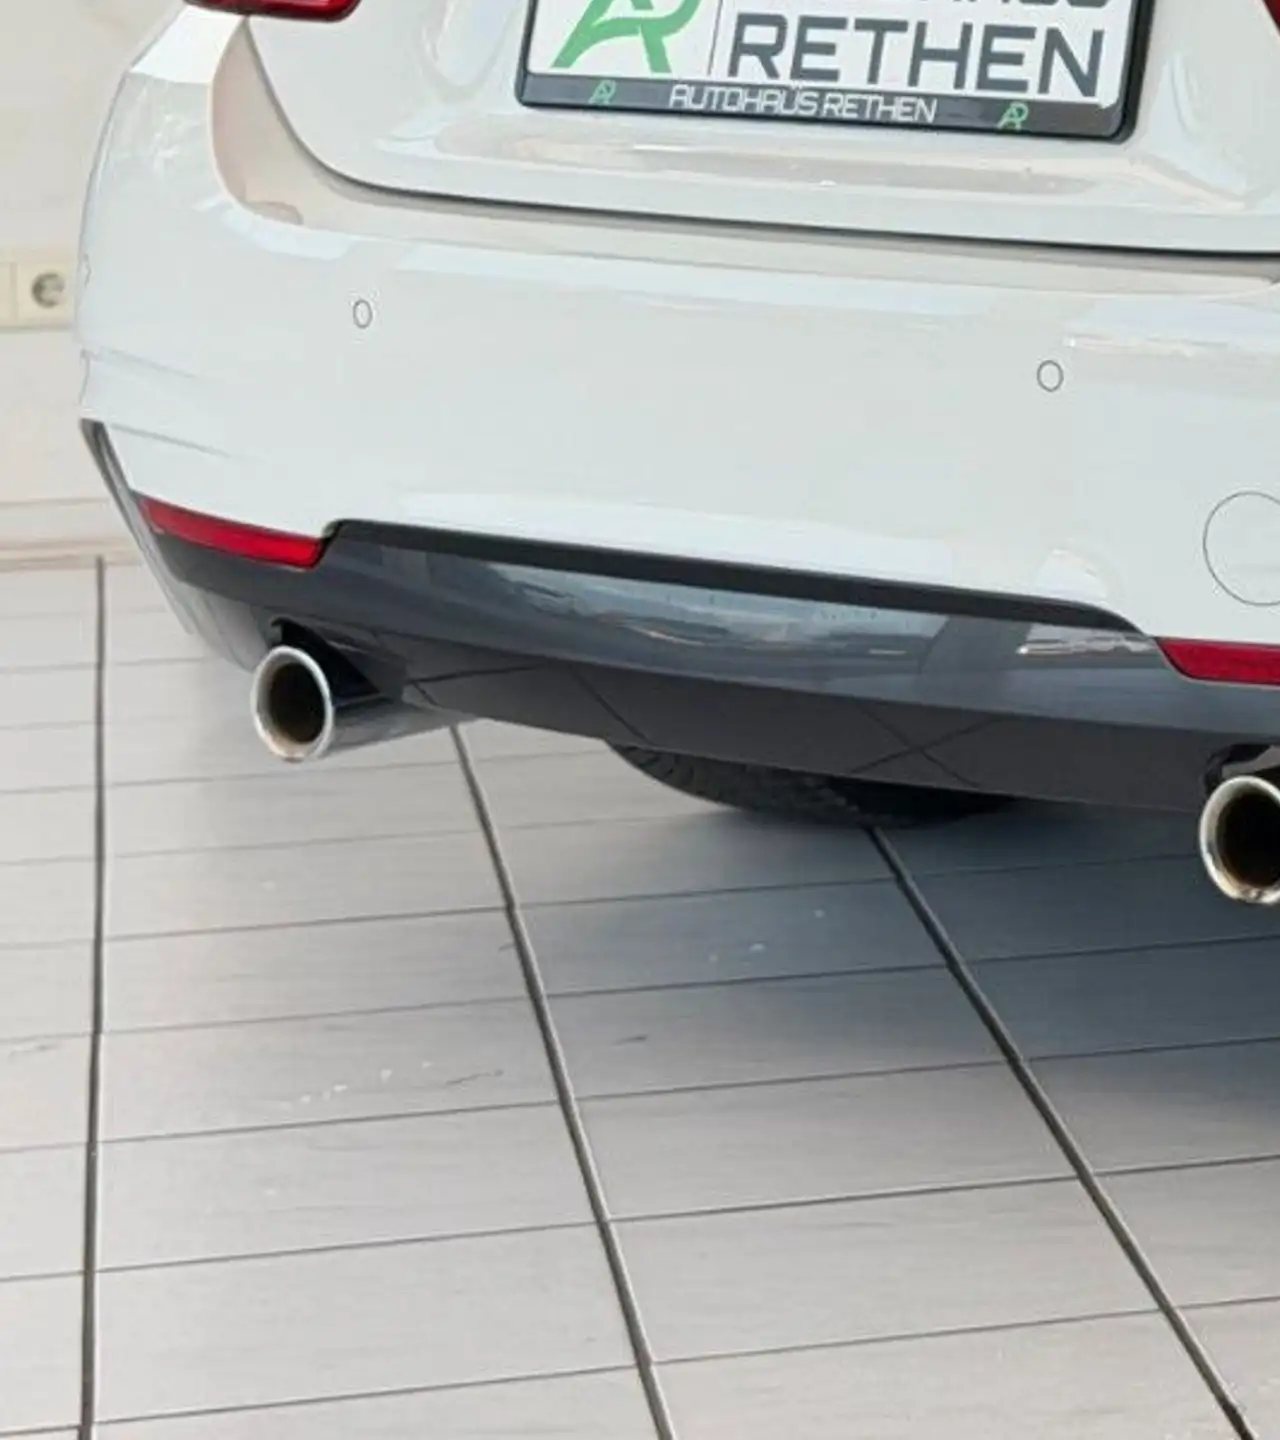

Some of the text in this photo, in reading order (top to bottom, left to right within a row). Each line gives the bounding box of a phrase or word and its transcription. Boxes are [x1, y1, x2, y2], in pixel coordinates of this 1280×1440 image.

[727, 12, 1104, 98] RETHEN
[669, 83, 938, 124] AUTOHAUS RETHEN
